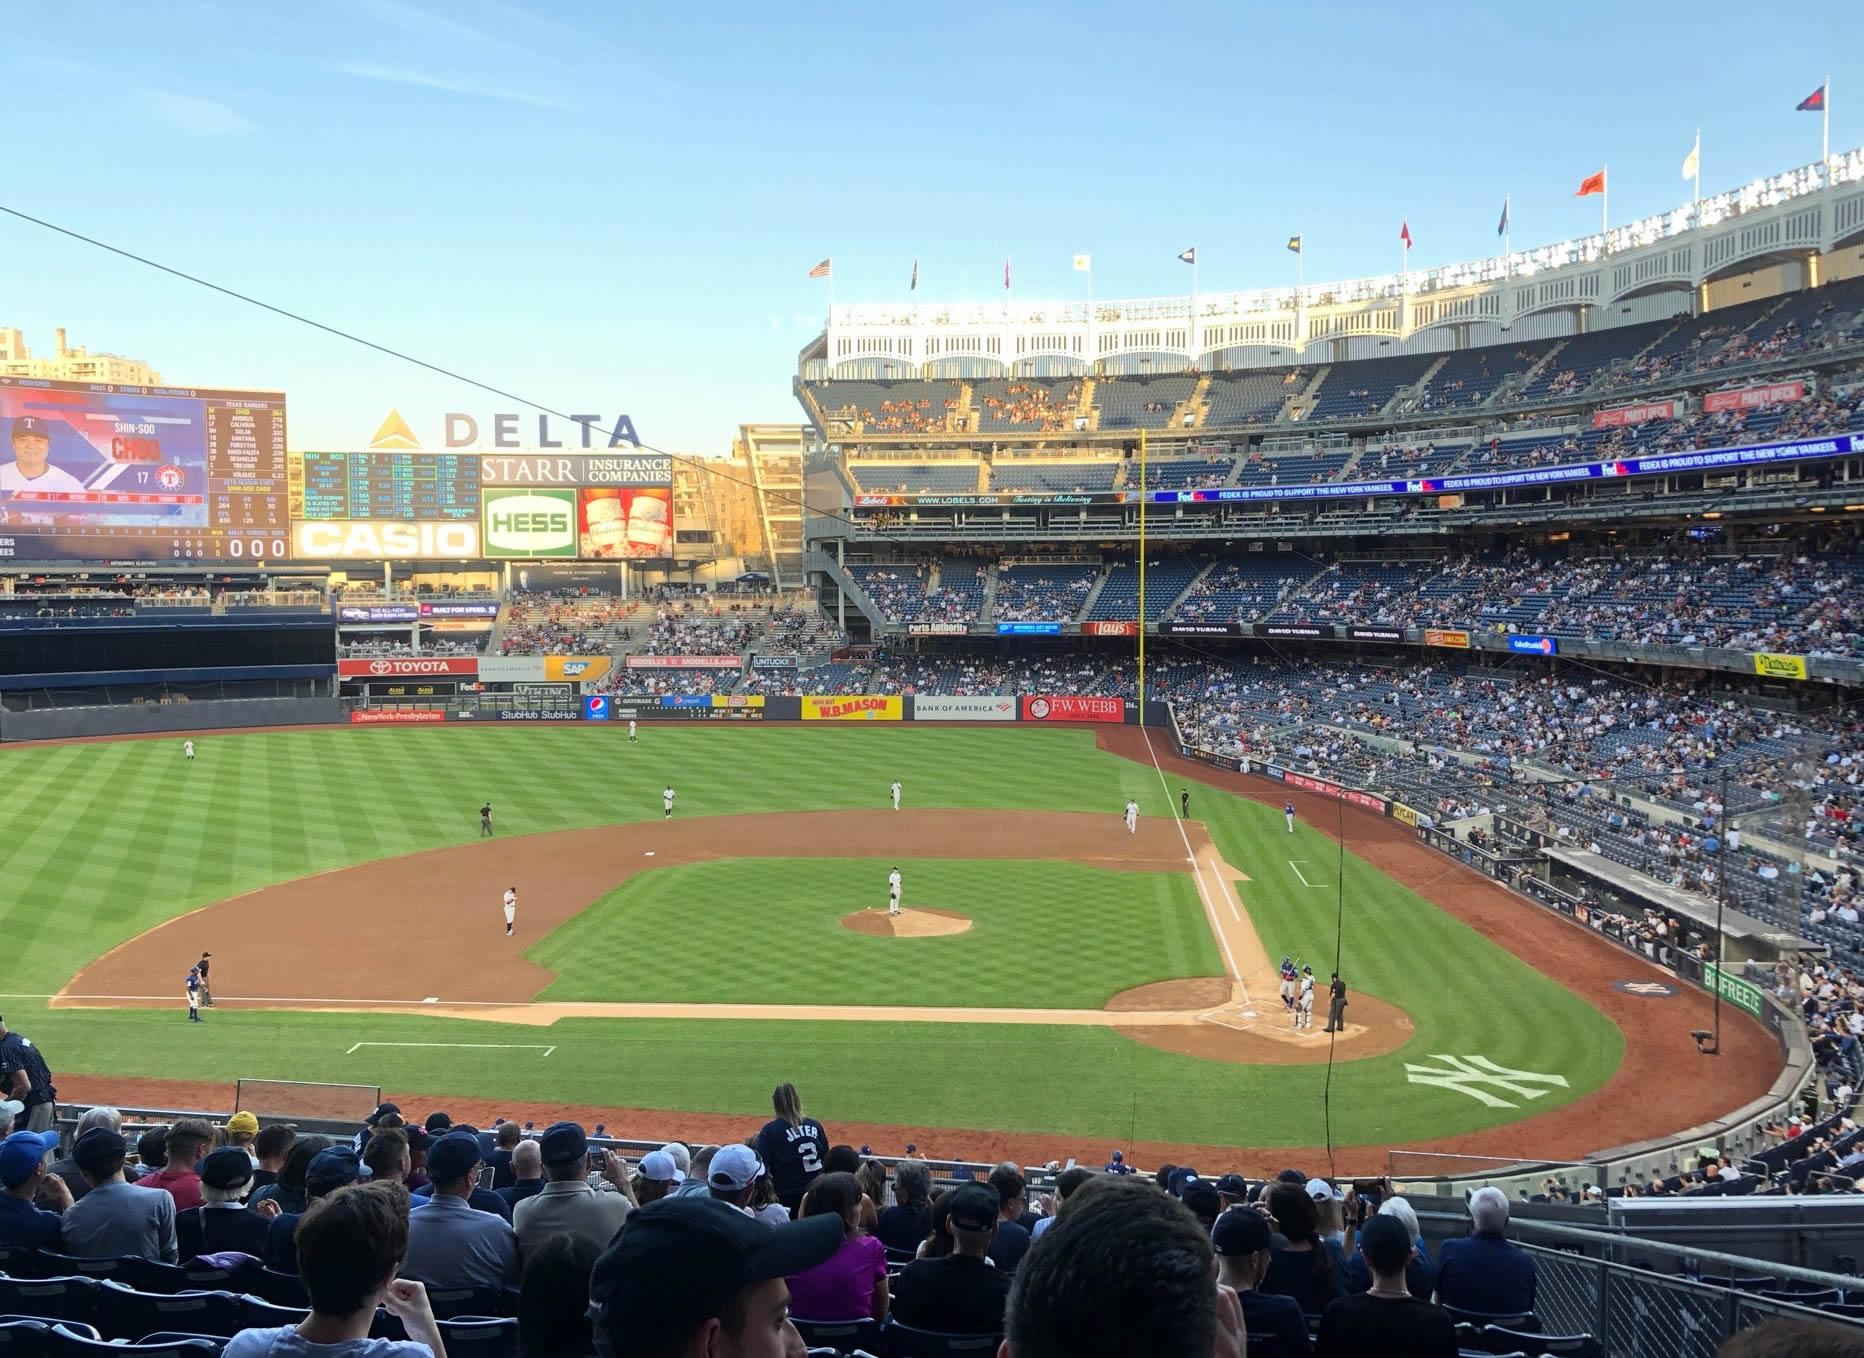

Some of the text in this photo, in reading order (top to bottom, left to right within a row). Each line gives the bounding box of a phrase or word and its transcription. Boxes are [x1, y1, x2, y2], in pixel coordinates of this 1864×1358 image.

[1741, 389, 1770, 404] PARTY
[1771, 384, 1797, 401] DECK
[1623, 408, 1647, 422] PARTY
[115, 422, 155, 434] SHIN-SOO
[446, 413, 641, 448] DELTA
[1639, 461, 1660, 471] FEDEX
[1661, 460, 1668, 469] IS
[1669, 457, 1693, 468] PROUD
[1693, 456, 1704, 466] TO
[1704, 453, 1739, 465] SUPPORT
[1740, 451, 1755, 461] THE
[1755, 449, 1775, 459] NEW
[482, 459, 672, 482] STARR INSURANCE
[588, 471, 672, 482] COMPANIES
[137, 471, 149, 484] 17
[1443, 479, 1463, 489] FEDEX
[1471, 477, 1493, 486] PROUD
[1492, 476, 1501, 485] TO
[1501, 474, 1525, 484] SUPPORT
[1525, 473, 1536, 482] THE
[1536, 472, 1547, 481] NEW
[1547, 470, 1564, 480] YORK
[1219, 491, 1241, 499] FEDEX
[1250, 490, 1273, 498] PROUD
[1273, 489, 1283, 497] TO
[1284, 488, 1315, 497] SUPPORT
[1317, 488, 1330, 496] THE
[1330, 487, 1344, 495] NEW
[1344, 486, 1364, 495] YORK
[1364, 484, 1395, 494] YANKEES.
[917, 496, 999, 504] WWW.LOBELS.COM
[492, 512, 568, 533] HESS
[302, 523, 477, 556] CASIO
[230, 540, 243, 557] 0
[251, 540, 264, 557] 0
[272, 540, 285, 557] 0
[433, 606, 450, 614] BUILT
[451, 606, 463, 614] FOR
[909, 623, 968, 634] Parts Authority
[1373, 631, 1400, 639] YURMAN
[393, 661, 449, 674] TOYOTA
[630, 657, 738, 667] MODELL'S MODELLS.com
[564, 663, 587, 675] SAP
[460, 682, 485, 691] FedEx
[516, 685, 569, 699] VIKING
[1051, 700, 1117, 713] F.W. WEBB
[501, 711, 577, 720] StubHub StubHub
[798, 1142, 823, 1173] 2
